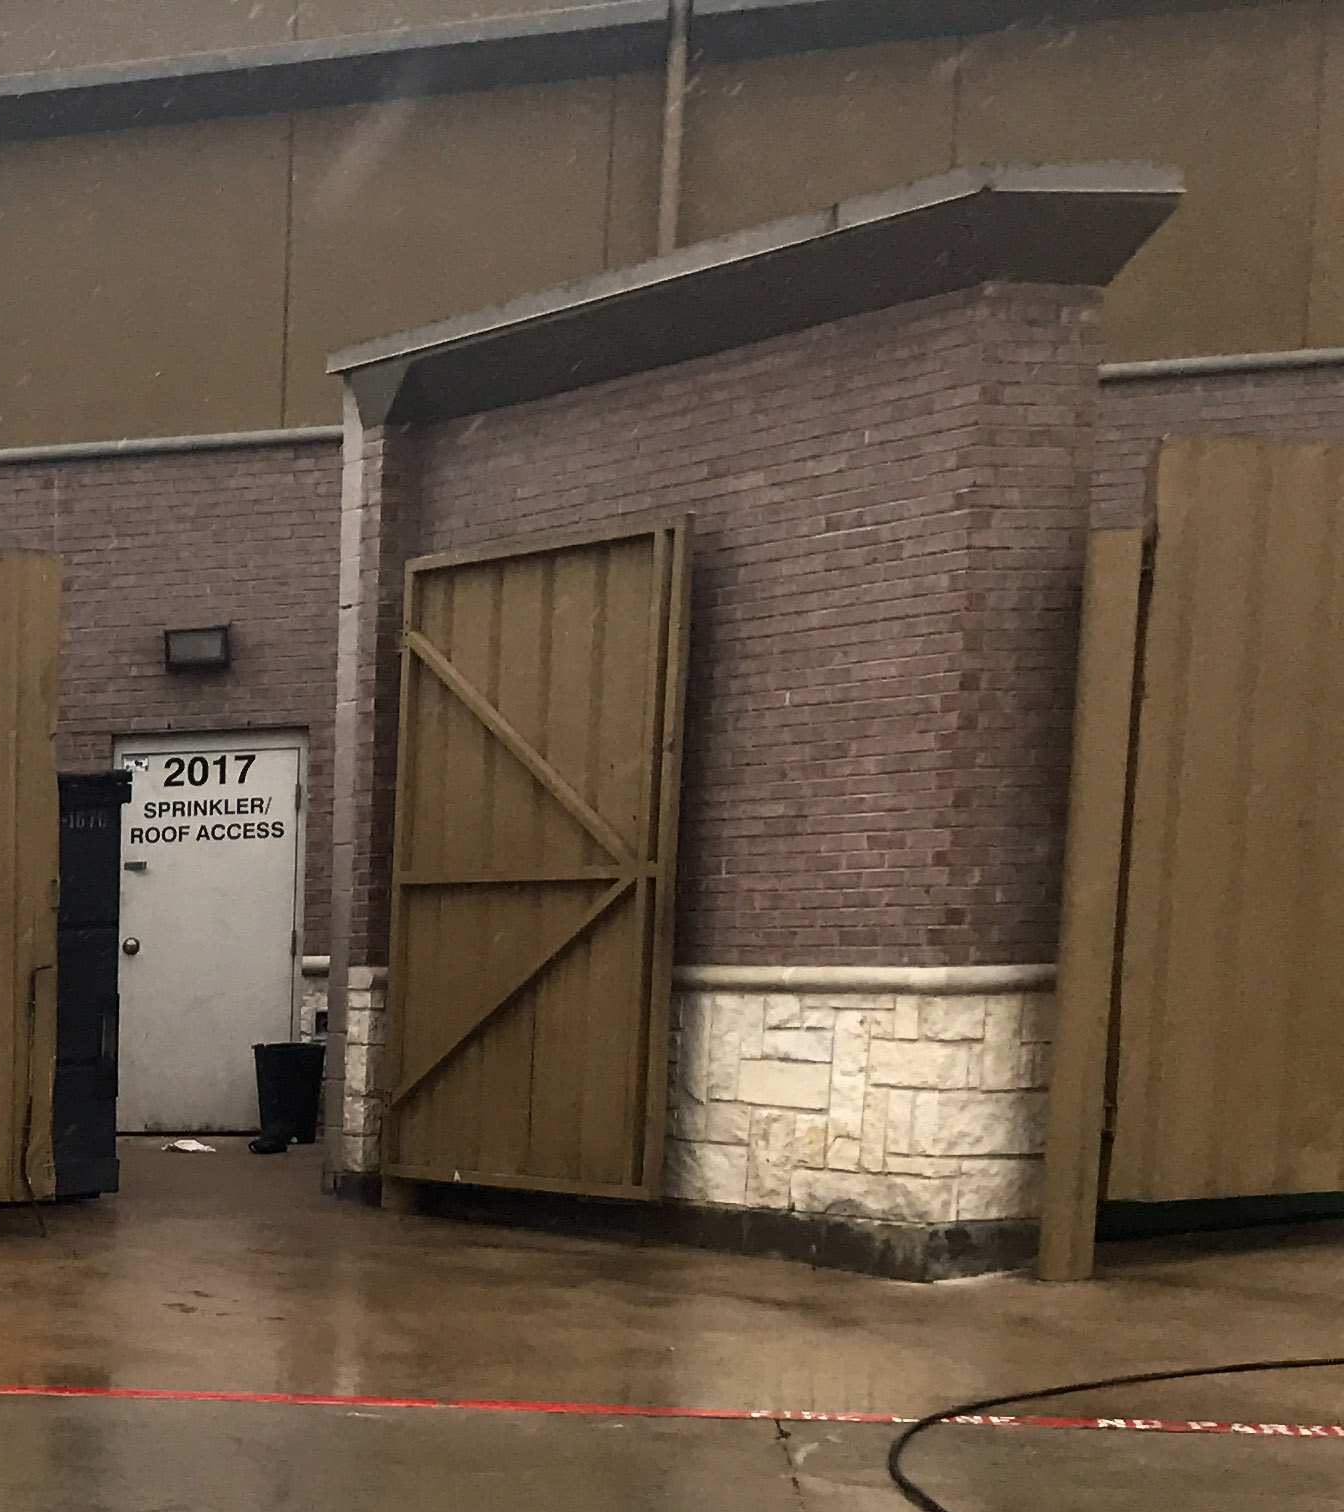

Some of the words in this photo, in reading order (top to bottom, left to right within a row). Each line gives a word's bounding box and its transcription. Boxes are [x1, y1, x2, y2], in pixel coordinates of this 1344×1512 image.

[163, 754, 256, 787] 2017
[143, 796, 272, 818] SPRINKLER/
[130, 825, 191, 844] ROOF
[196, 821, 285, 842] ACCESS
[892, 1415, 1021, 1426] LNE
[1096, 1417, 1162, 1430] NO
